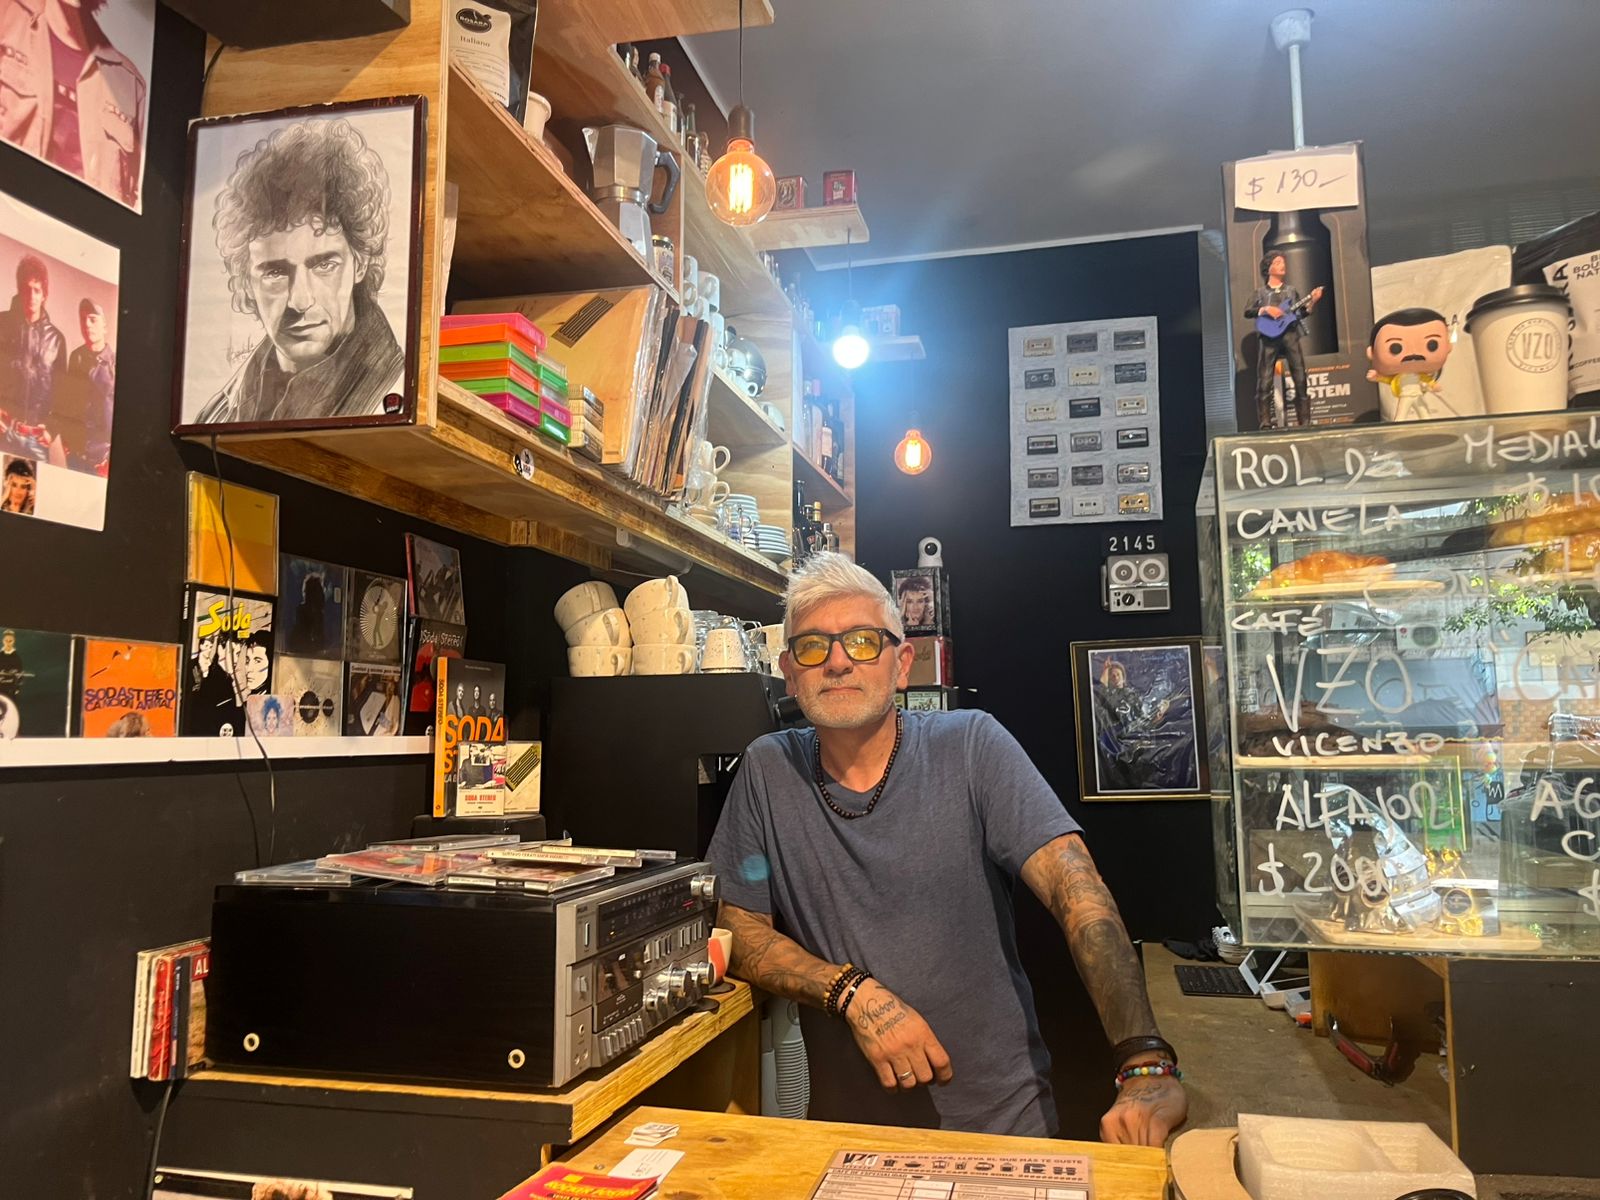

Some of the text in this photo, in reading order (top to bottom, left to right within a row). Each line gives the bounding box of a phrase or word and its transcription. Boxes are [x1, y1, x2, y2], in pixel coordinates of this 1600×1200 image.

[460, 35, 490, 47] Italiano
[1244, 176, 1265, 202] $
[1521, 332, 1554, 360] VZO
[1286, 383, 1351, 402] SSTEM
[1231, 443, 1324, 490] ROL
[1236, 497, 1405, 540] CANELA
[1108, 534, 1155, 552] 2145
[198, 600, 252, 639] Soda
[1231, 604, 1326, 636] CAFÉ
[1265, 648, 1413, 732] VZO
[444, 714, 504, 749] SODA
[1272, 729, 1445, 757] VICENZO
[1275, 780, 1454, 848] ALFAJOR
[1257, 843, 1286, 898] $
